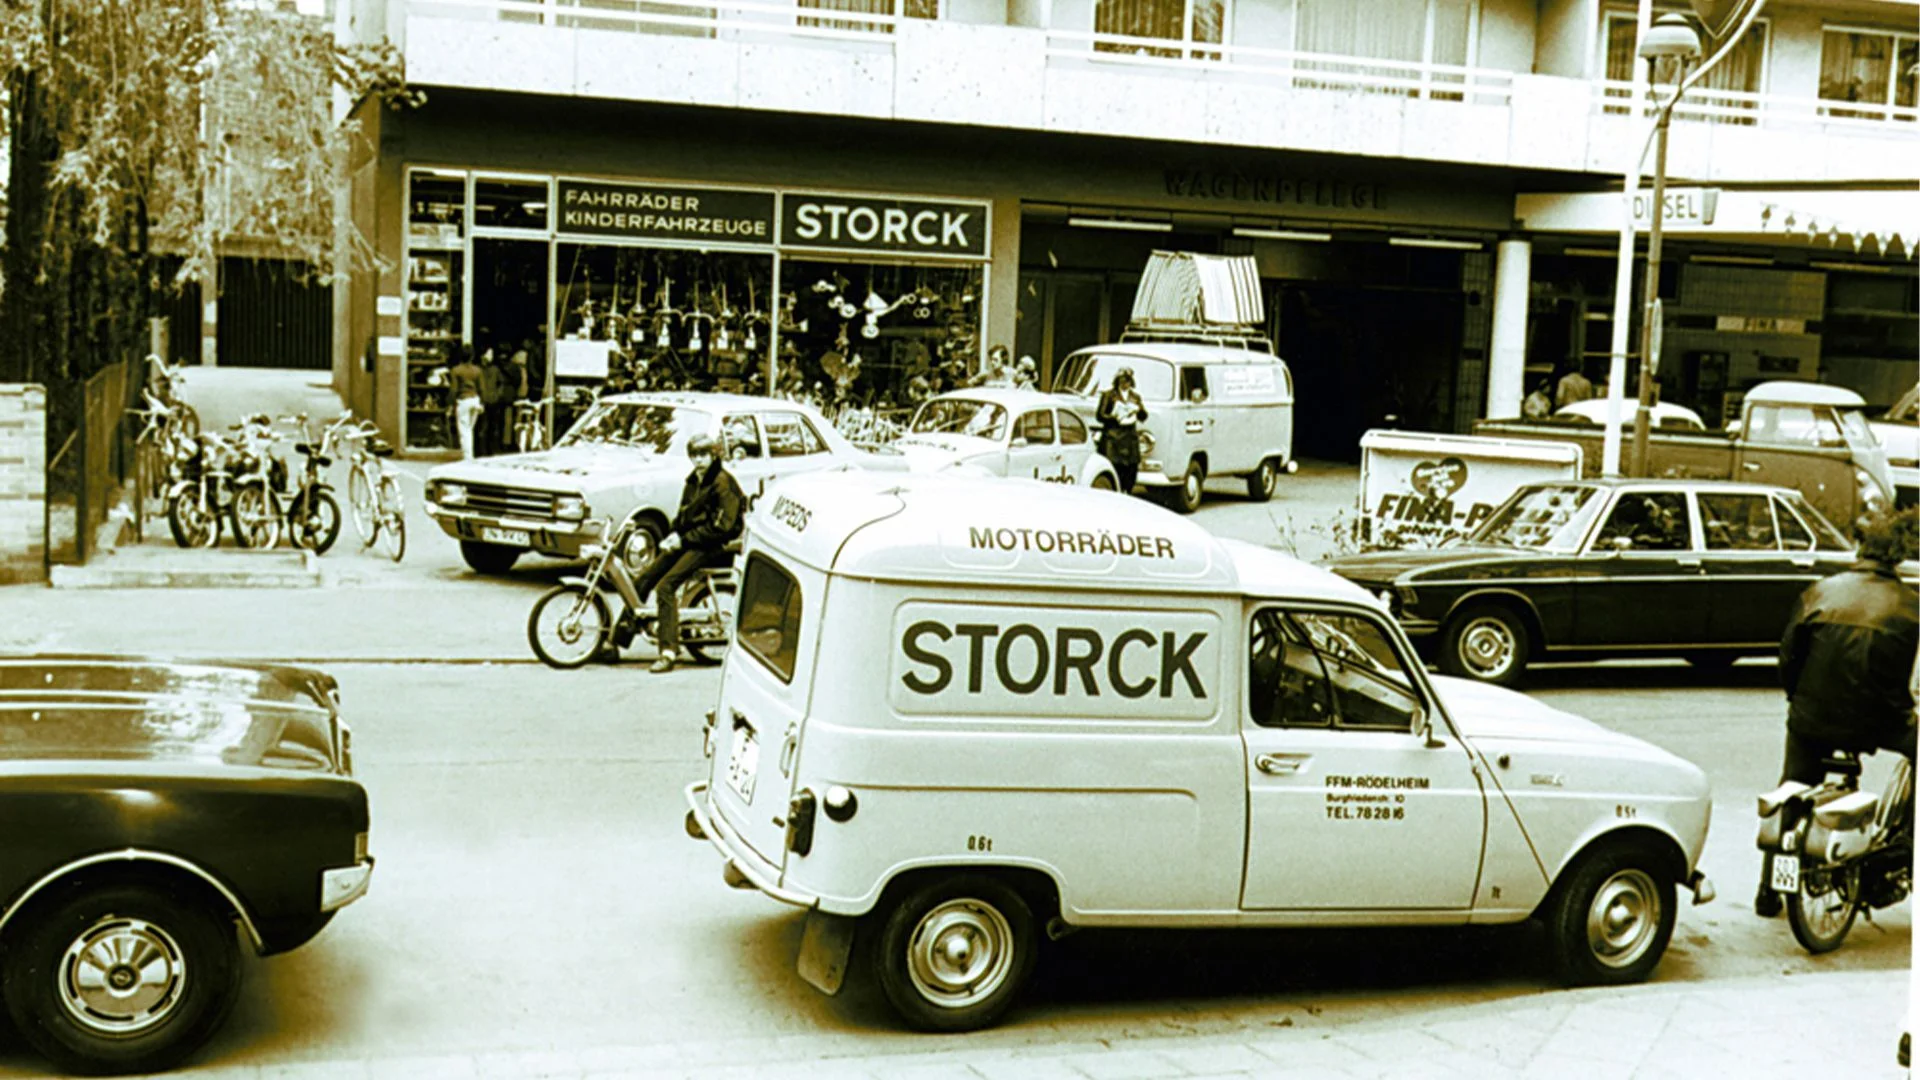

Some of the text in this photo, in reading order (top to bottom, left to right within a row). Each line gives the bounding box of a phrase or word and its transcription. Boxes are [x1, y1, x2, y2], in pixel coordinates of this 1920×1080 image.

[565, 190, 699, 212] FAHRRÄDER
[1163, 168, 1389, 209] WAGENPFLEGE
[1633, 194, 1698, 219] DISEL
[565, 212, 766, 236] KINDERFAHRZEUGE
[796, 203, 972, 247] STORCK
[969, 527, 1176, 560] MOTORRÄDER
[901, 620, 1208, 699] STORCK
[1325, 774, 1430, 789] FFM-RÖDELHEIM
